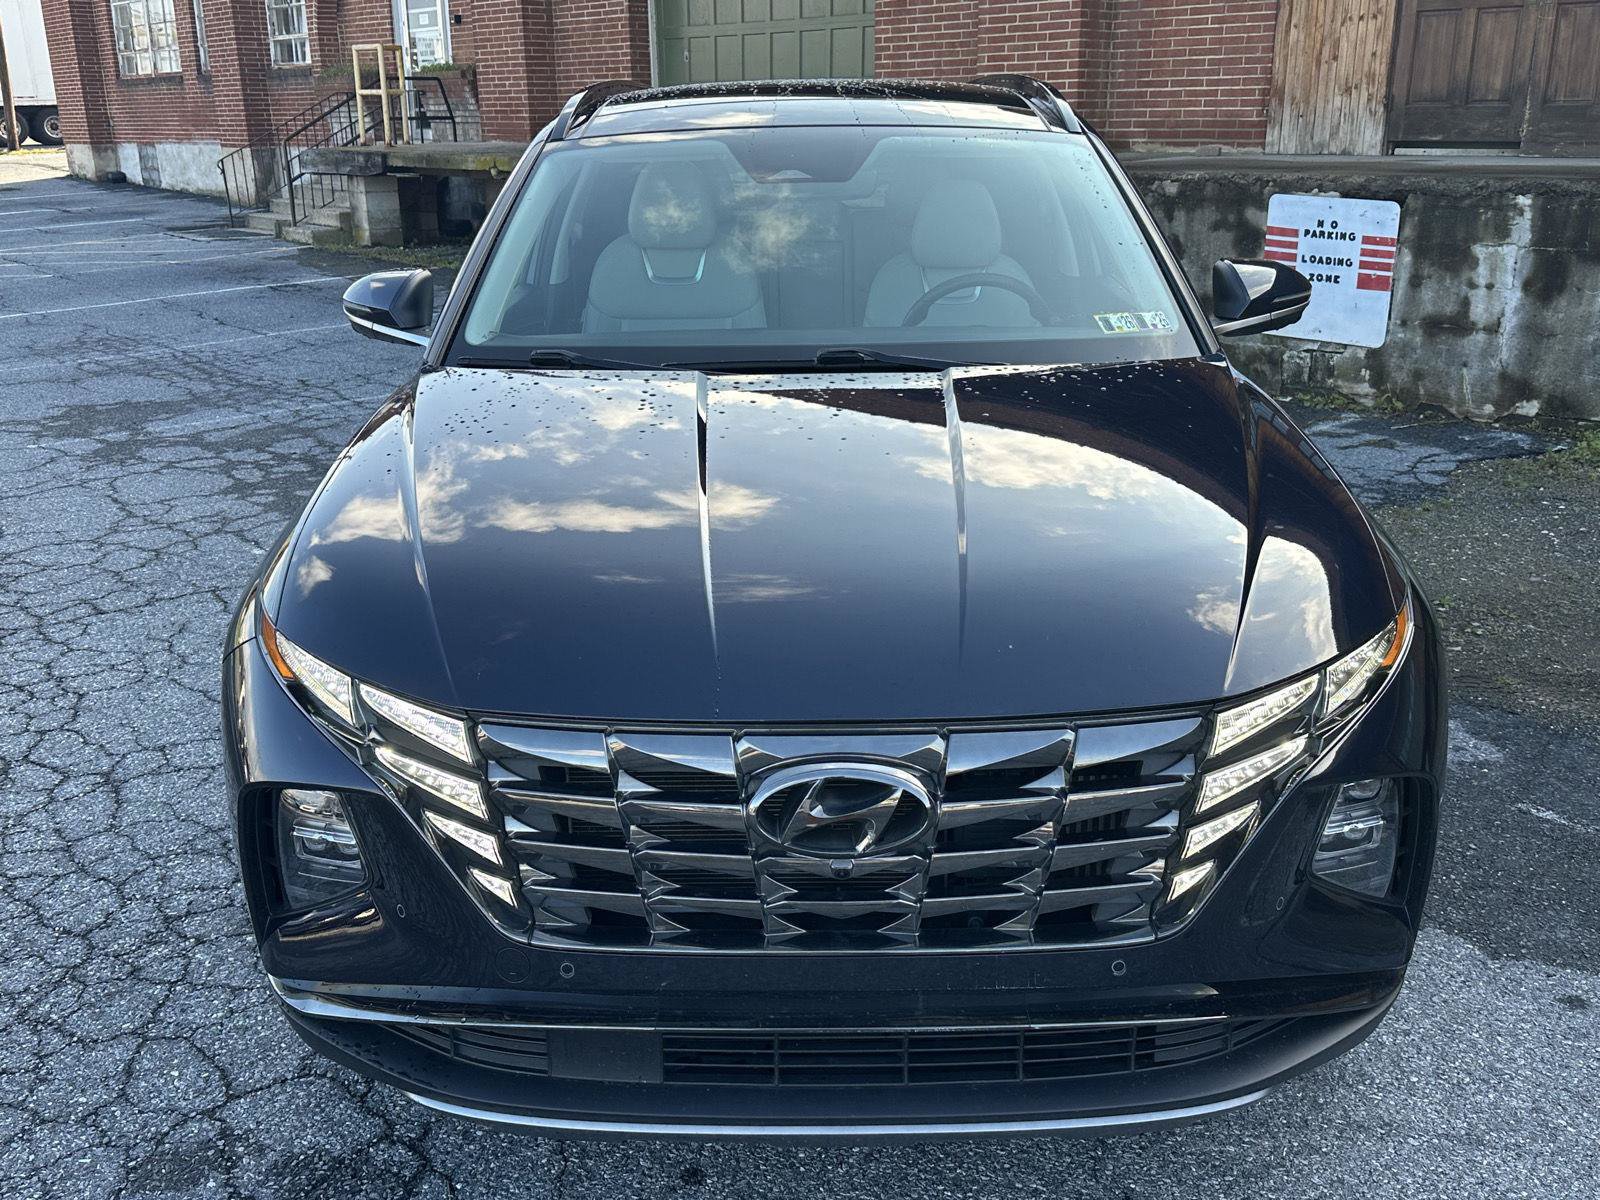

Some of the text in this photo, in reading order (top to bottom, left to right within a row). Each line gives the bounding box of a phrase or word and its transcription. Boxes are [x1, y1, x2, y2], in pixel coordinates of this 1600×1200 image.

[1317, 219, 1338, 229] NO
[1304, 229, 1356, 241] PARKING
[1301, 255, 1353, 267] LOADING
[1309, 273, 1340, 284] ZONE
